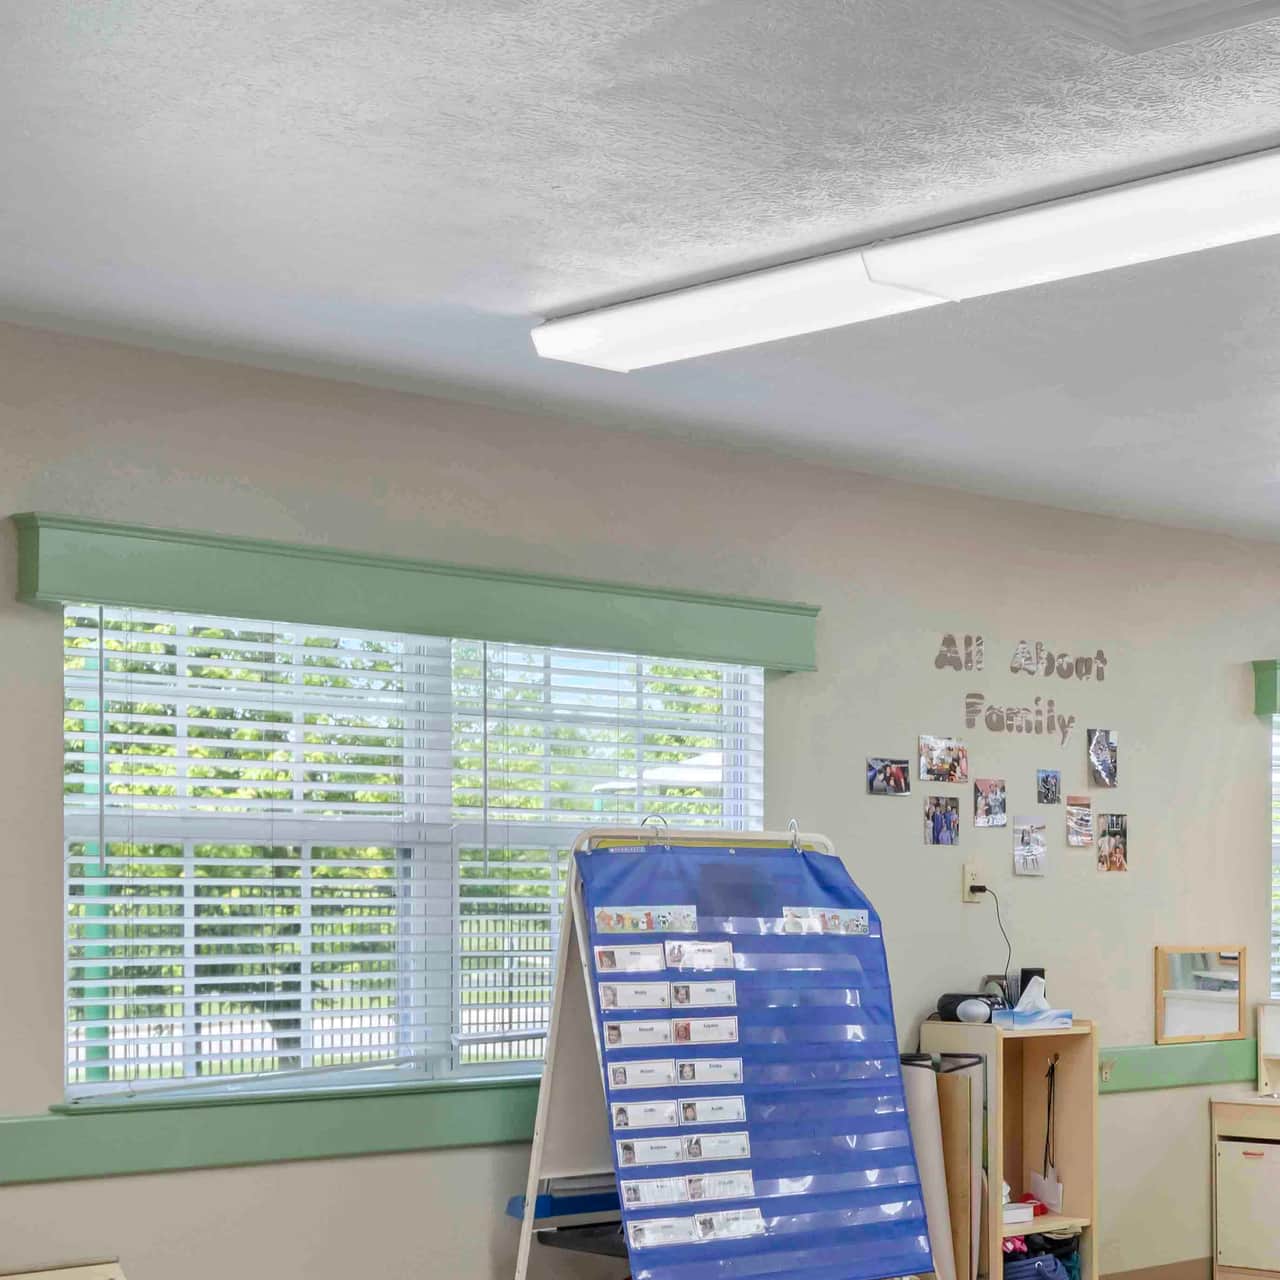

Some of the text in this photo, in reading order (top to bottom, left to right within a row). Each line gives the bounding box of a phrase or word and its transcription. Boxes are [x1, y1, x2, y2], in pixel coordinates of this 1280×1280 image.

[935, 633, 1107, 681] All About
[965, 692, 1075, 746] Family
